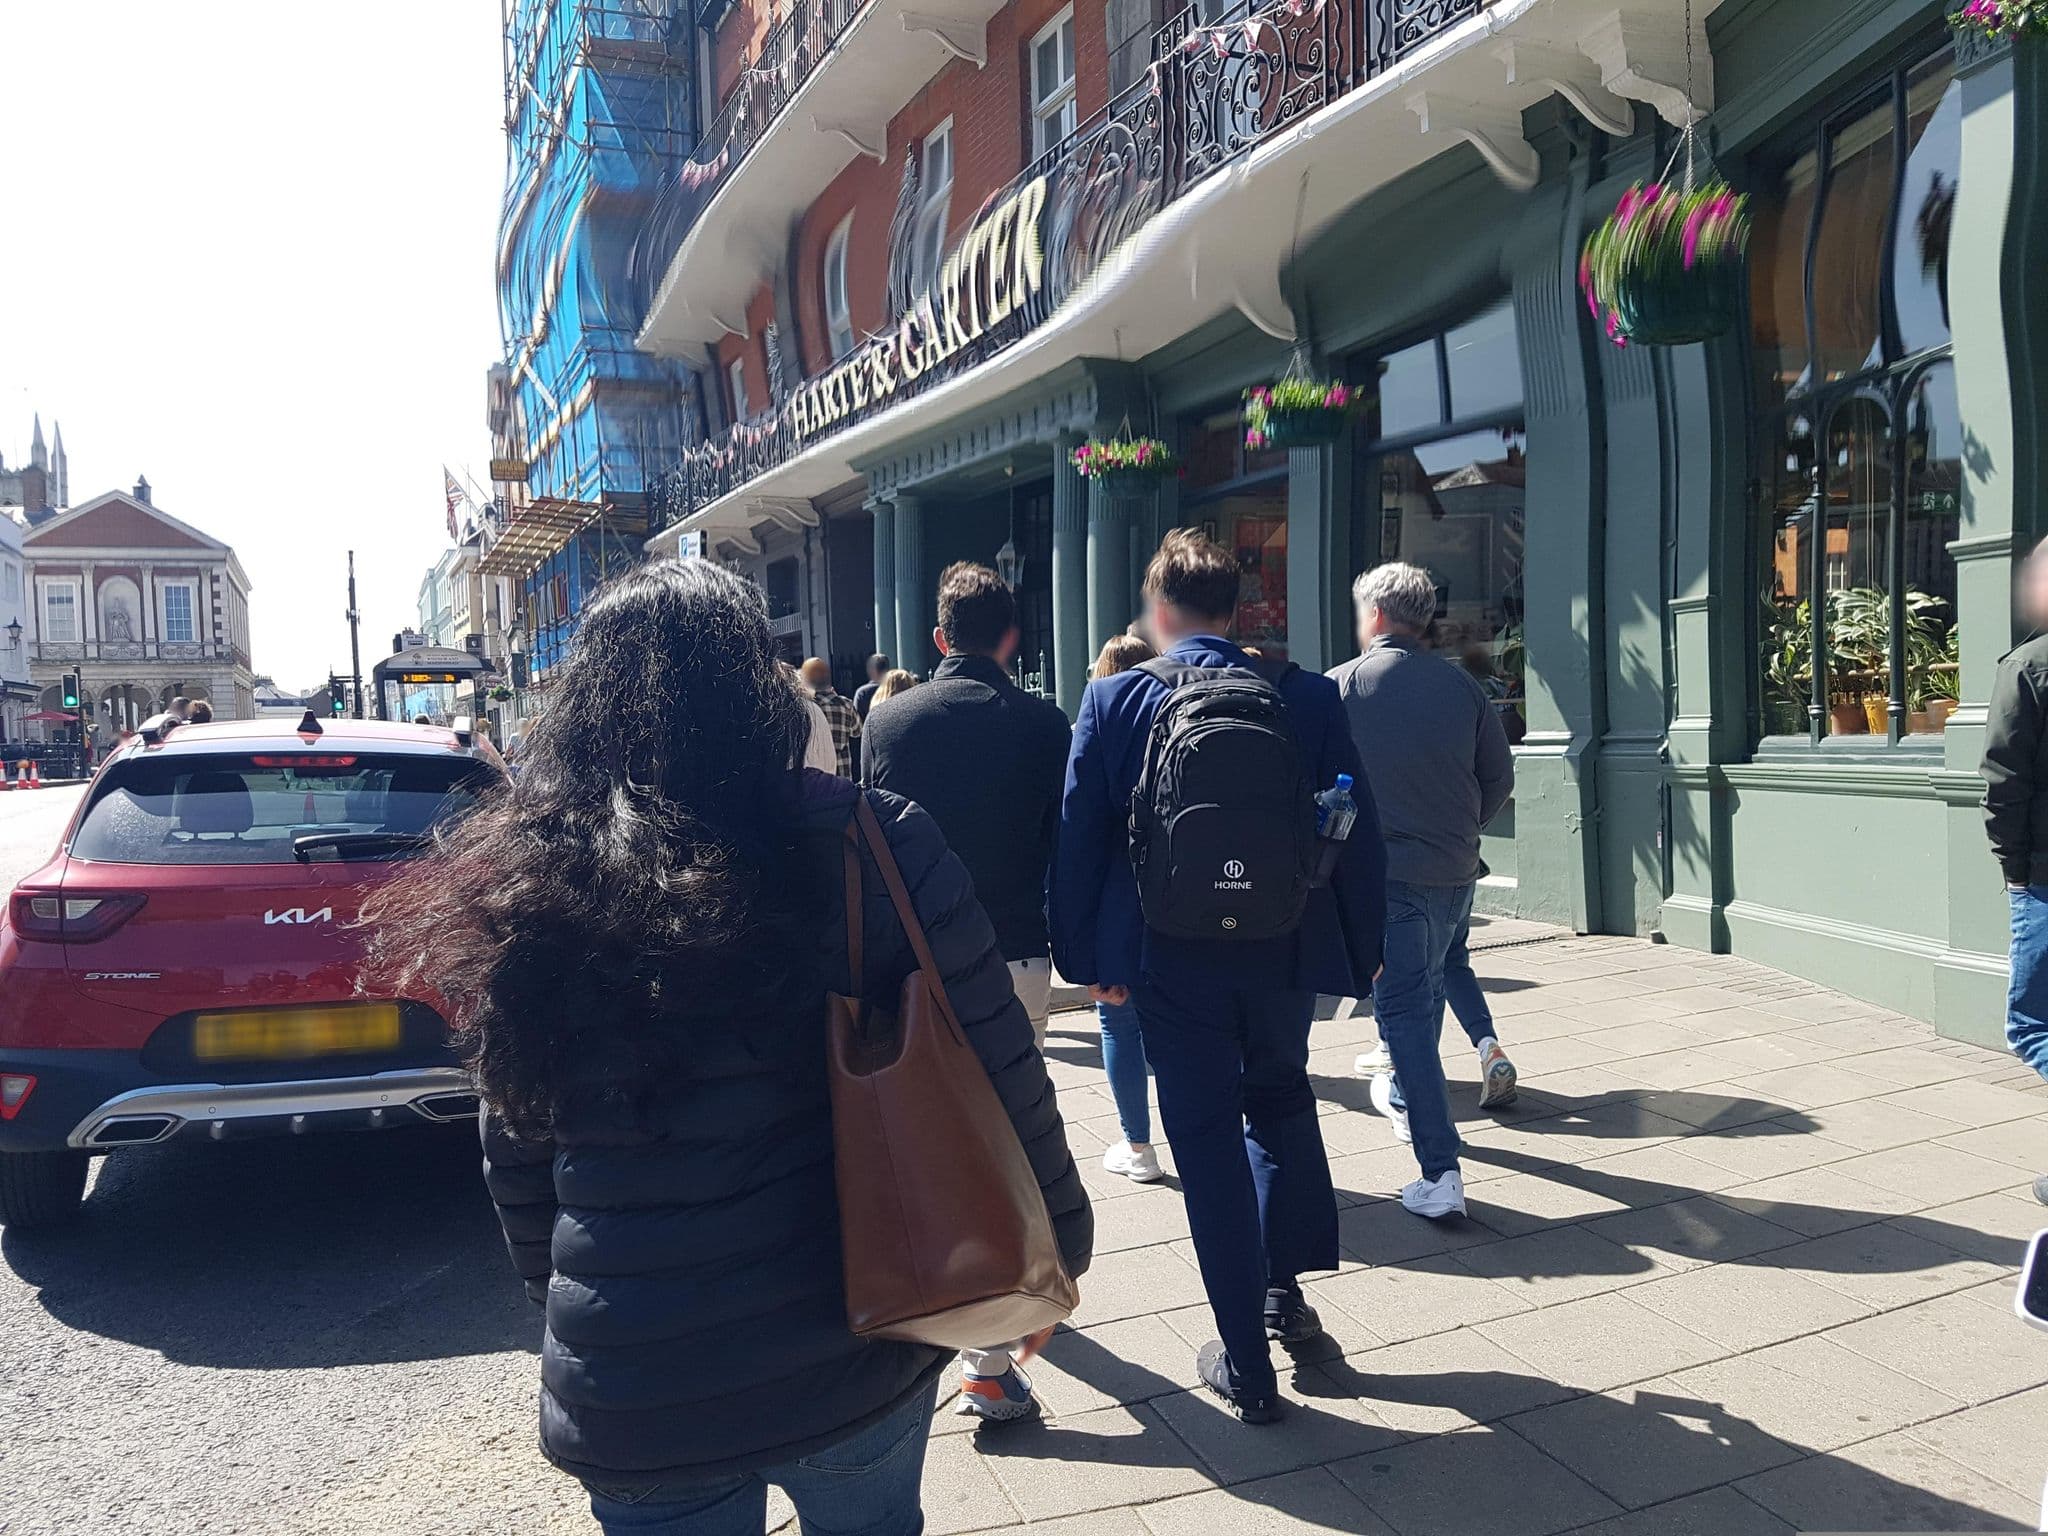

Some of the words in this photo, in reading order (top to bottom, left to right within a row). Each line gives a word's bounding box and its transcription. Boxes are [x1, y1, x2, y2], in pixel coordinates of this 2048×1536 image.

[791, 357, 869, 440] HARTE
[870, 345, 897, 395] &
[900, 175, 1046, 381] GARTER
[1215, 881, 1252, 889] HORNE
[84, 972, 160, 980] STONIC
